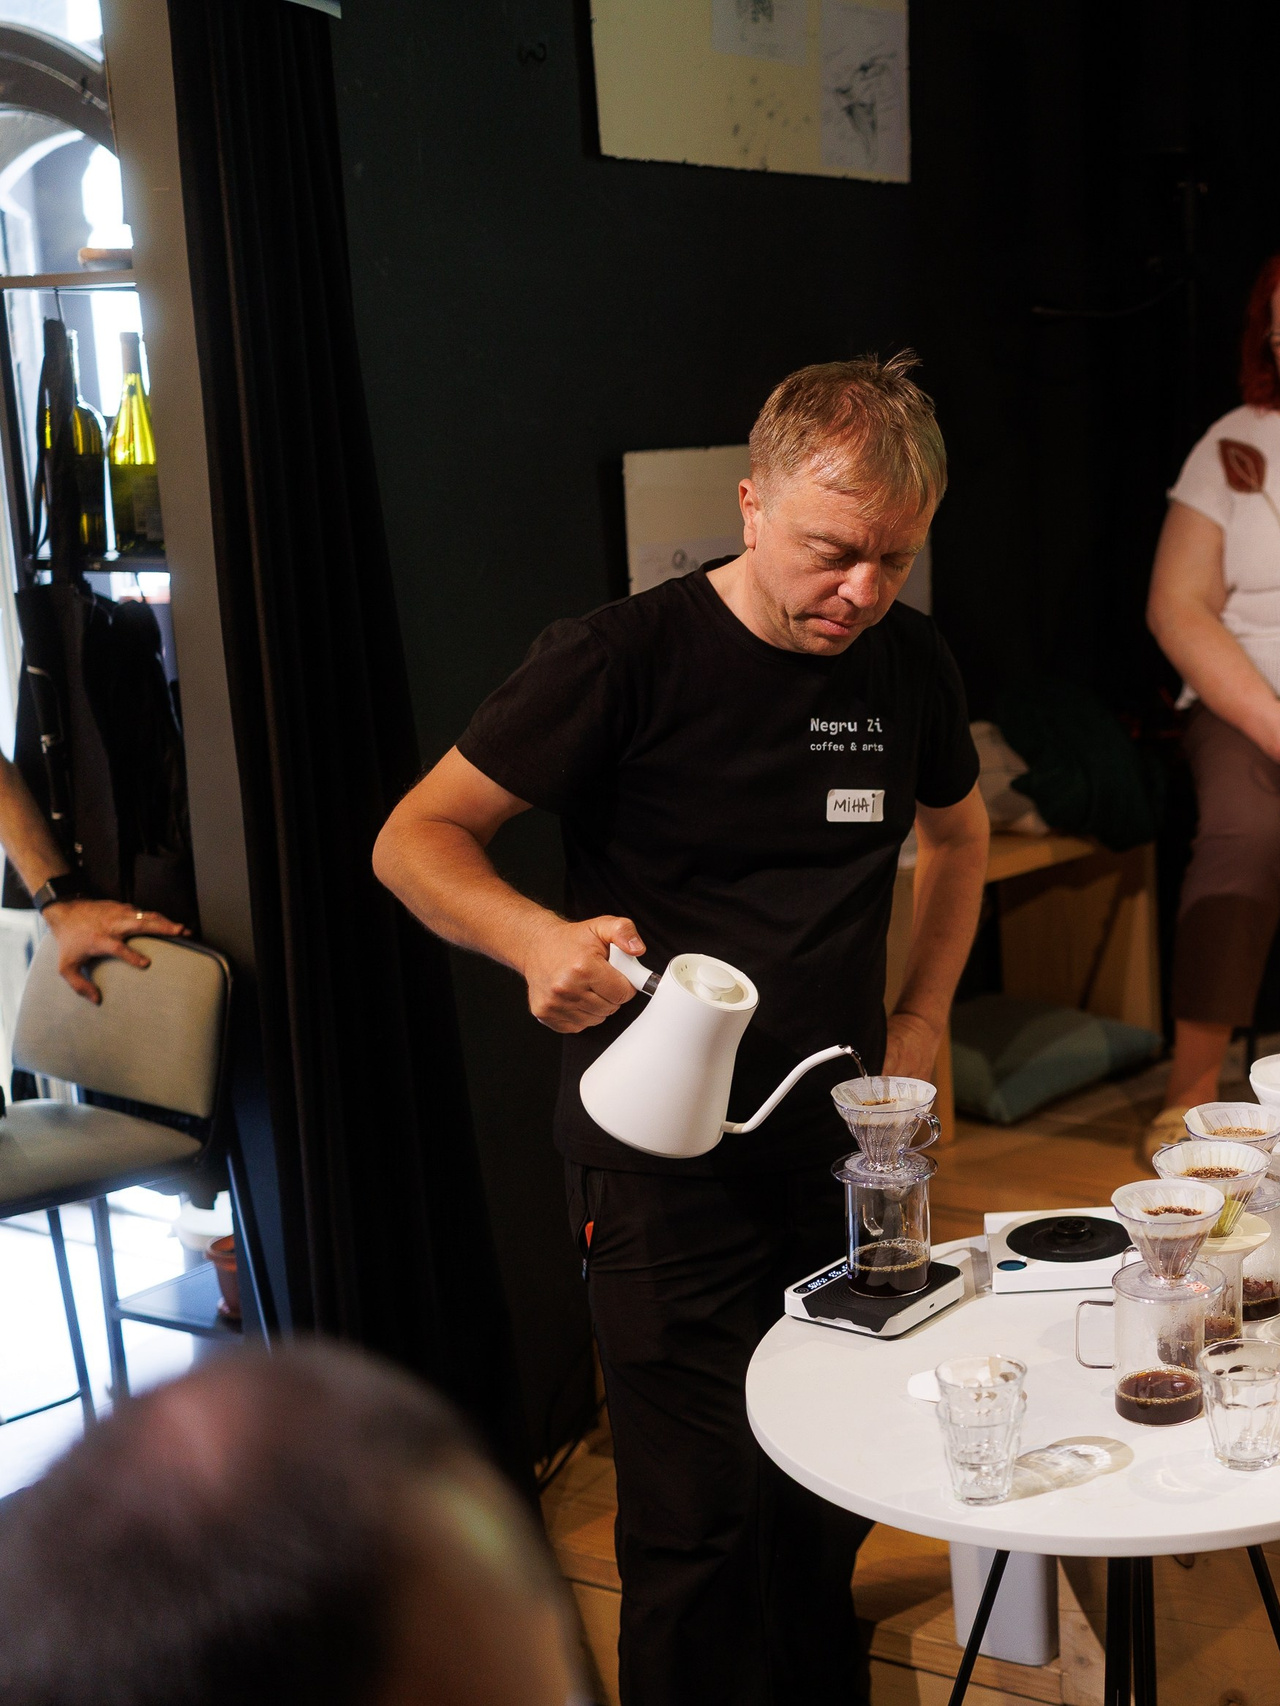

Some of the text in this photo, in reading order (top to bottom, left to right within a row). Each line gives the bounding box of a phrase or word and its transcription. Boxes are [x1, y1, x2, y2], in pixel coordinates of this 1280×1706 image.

[810, 718, 883, 735] Negru Zi
[810, 741, 884, 752] coffee & arts
